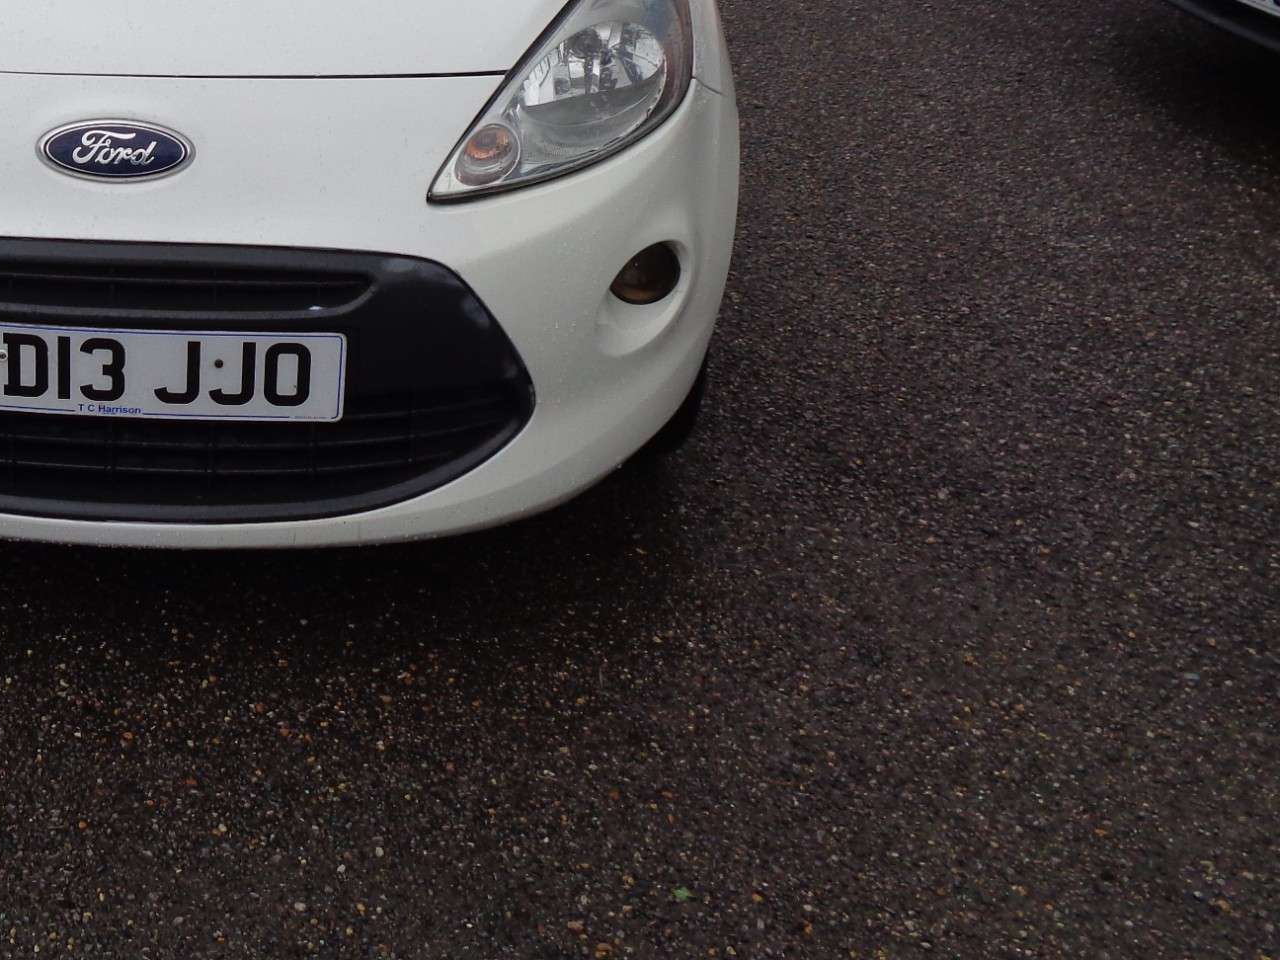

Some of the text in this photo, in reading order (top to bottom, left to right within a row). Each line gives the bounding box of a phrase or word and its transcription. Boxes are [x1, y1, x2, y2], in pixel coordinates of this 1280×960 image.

[72, 129, 158, 165] Ford
[154, 341, 312, 407] JJO
[78, 404, 142, 415] T C Harrison
